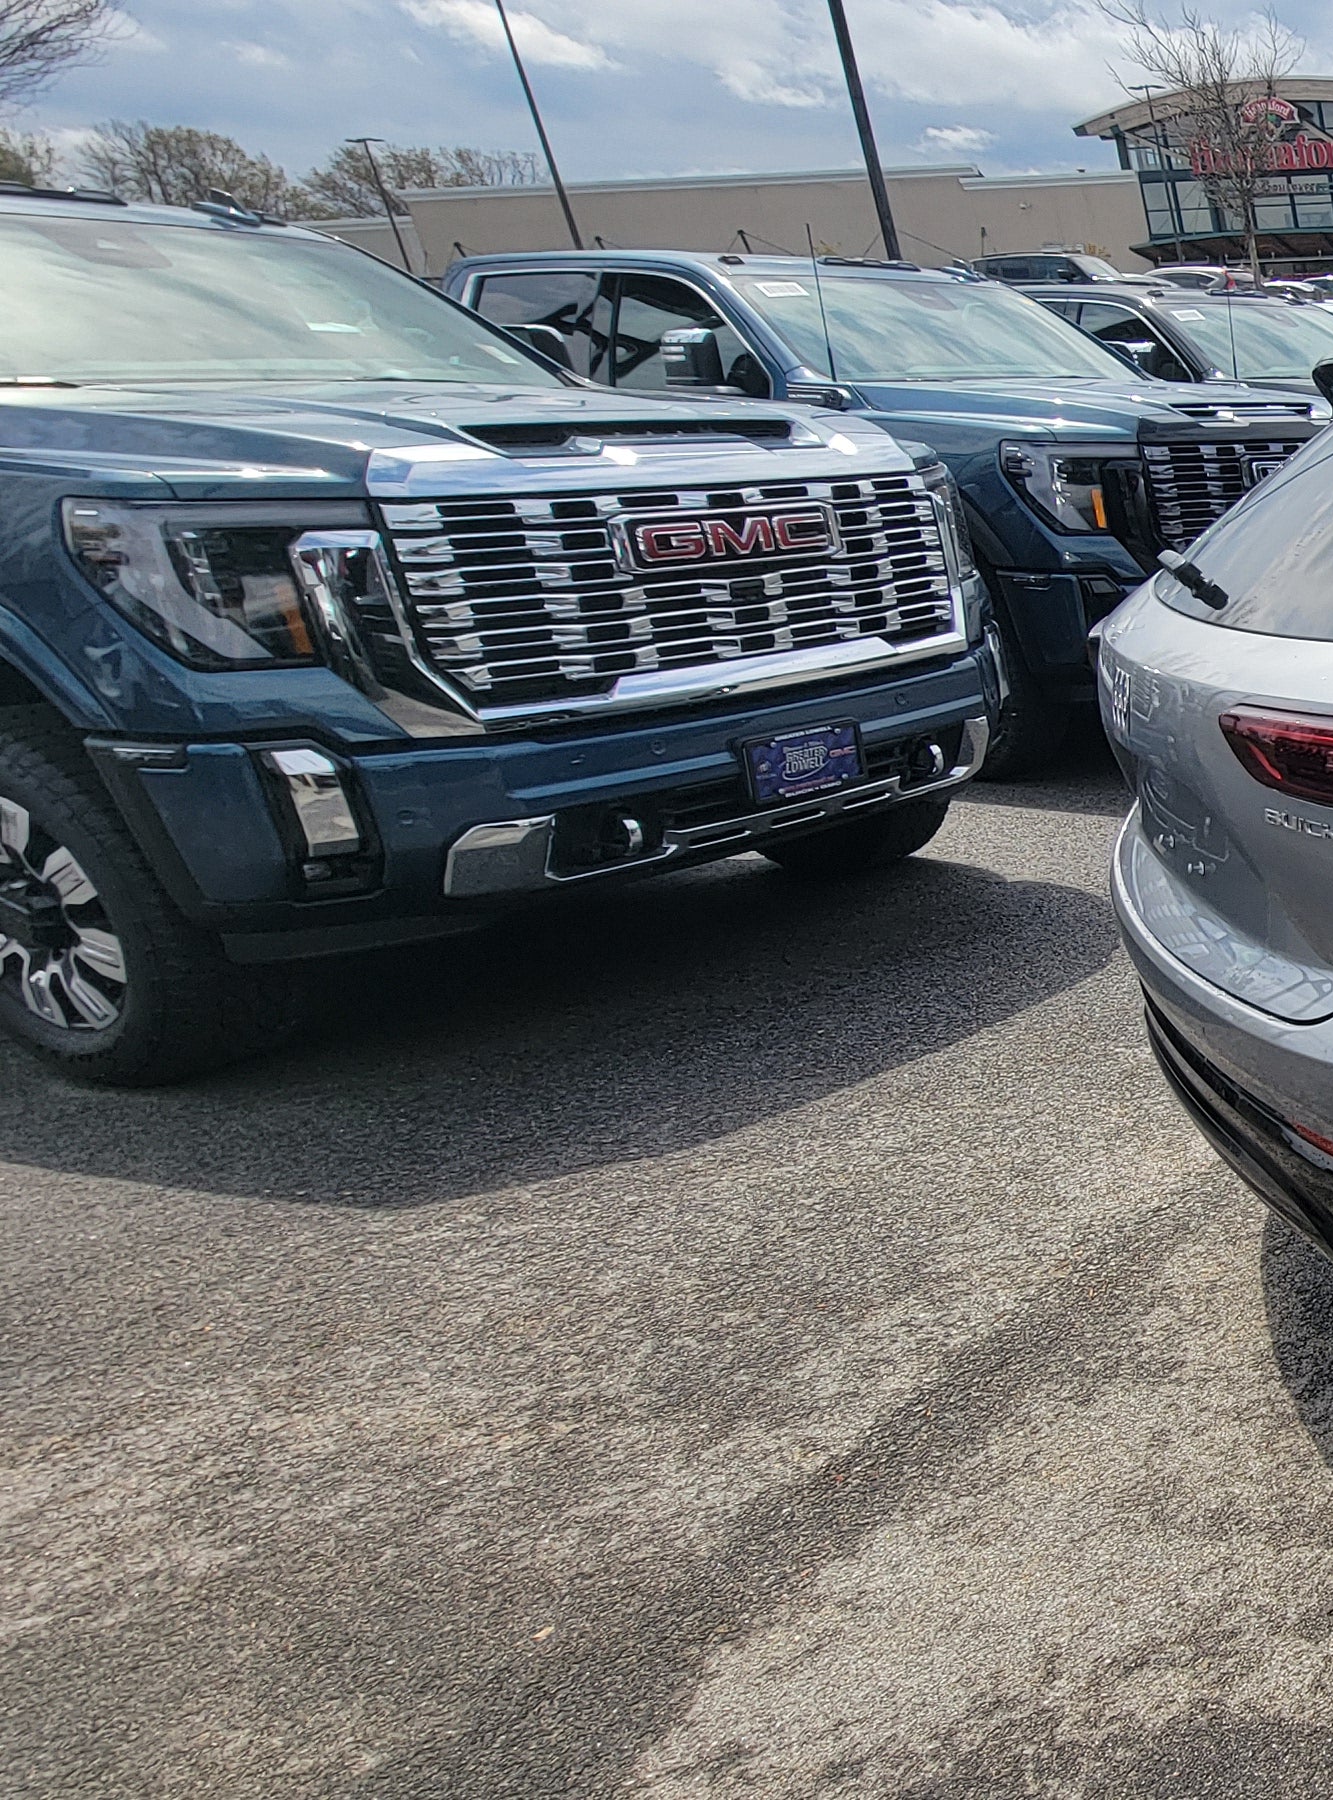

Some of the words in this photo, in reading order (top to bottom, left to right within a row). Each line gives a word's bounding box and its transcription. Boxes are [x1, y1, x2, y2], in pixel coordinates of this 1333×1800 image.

[1244, 101, 1291, 117] Hanford
[635, 512, 828, 562] GMC
[785, 747, 826, 762] GREATER
[785, 756, 825, 774] LOWELL
